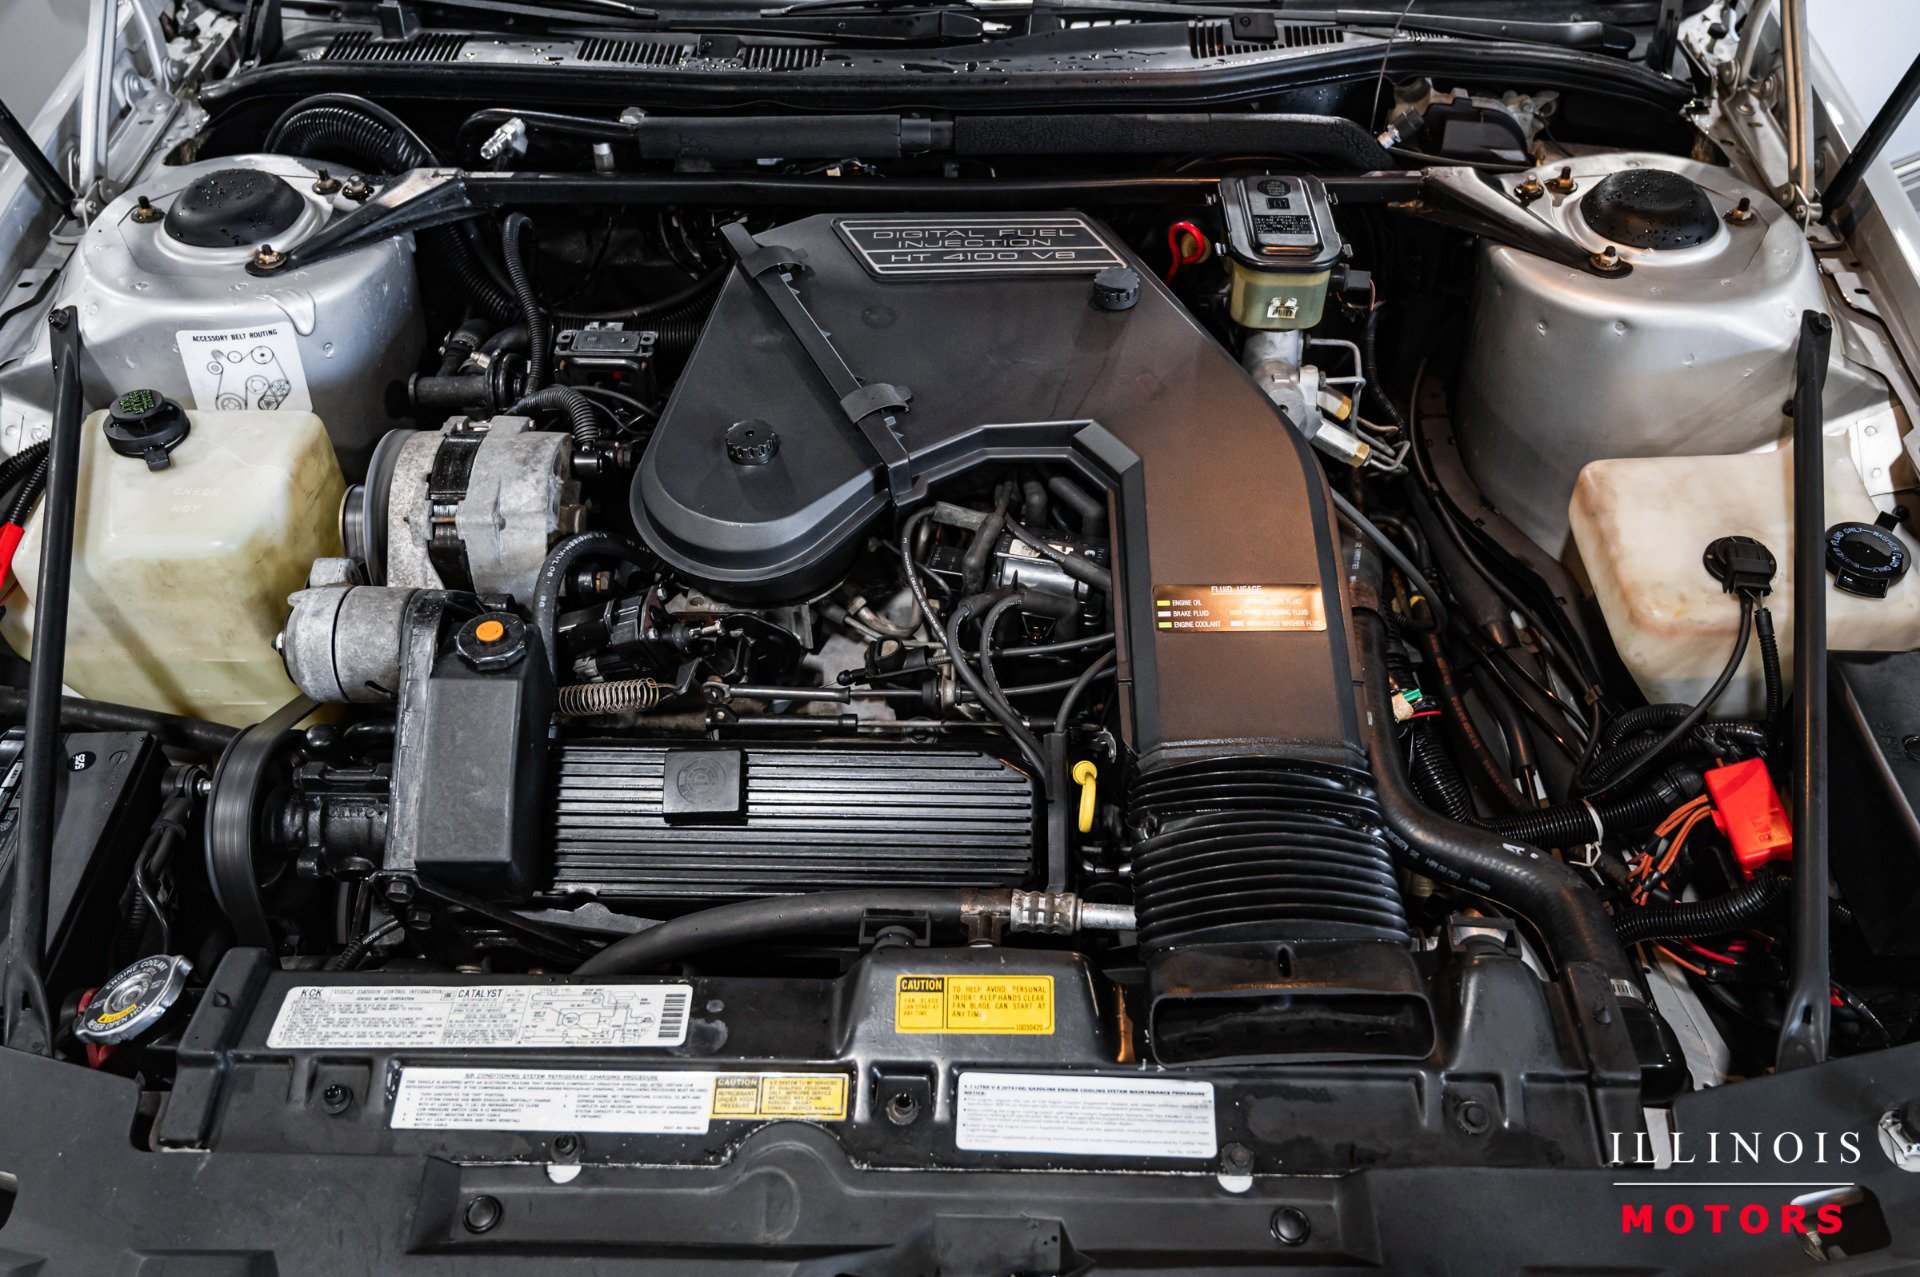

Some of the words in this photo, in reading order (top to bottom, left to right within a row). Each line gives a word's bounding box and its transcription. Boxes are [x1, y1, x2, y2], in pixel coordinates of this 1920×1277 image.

[873, 230, 985, 239] DIGITAL
[999, 229, 1075, 238] FUEL
[898, 238, 1051, 248] INJECTION
[891, 253, 932, 262] HT
[943, 252, 1018, 261] 4100
[1032, 251, 1076, 260] V8
[249, 329, 278, 338] ROUTING
[74, 753, 86, 770] 5/25
[105, 964, 138, 990] ENGINE
[140, 959, 168, 972] COOLANT
[901, 980, 942, 991] CAUTION
[458, 989, 503, 998] CATALYST
[105, 1016, 128, 1030] OPEN
[130, 1002, 147, 1018] HOT
[718, 1078, 757, 1086] CAUTION
